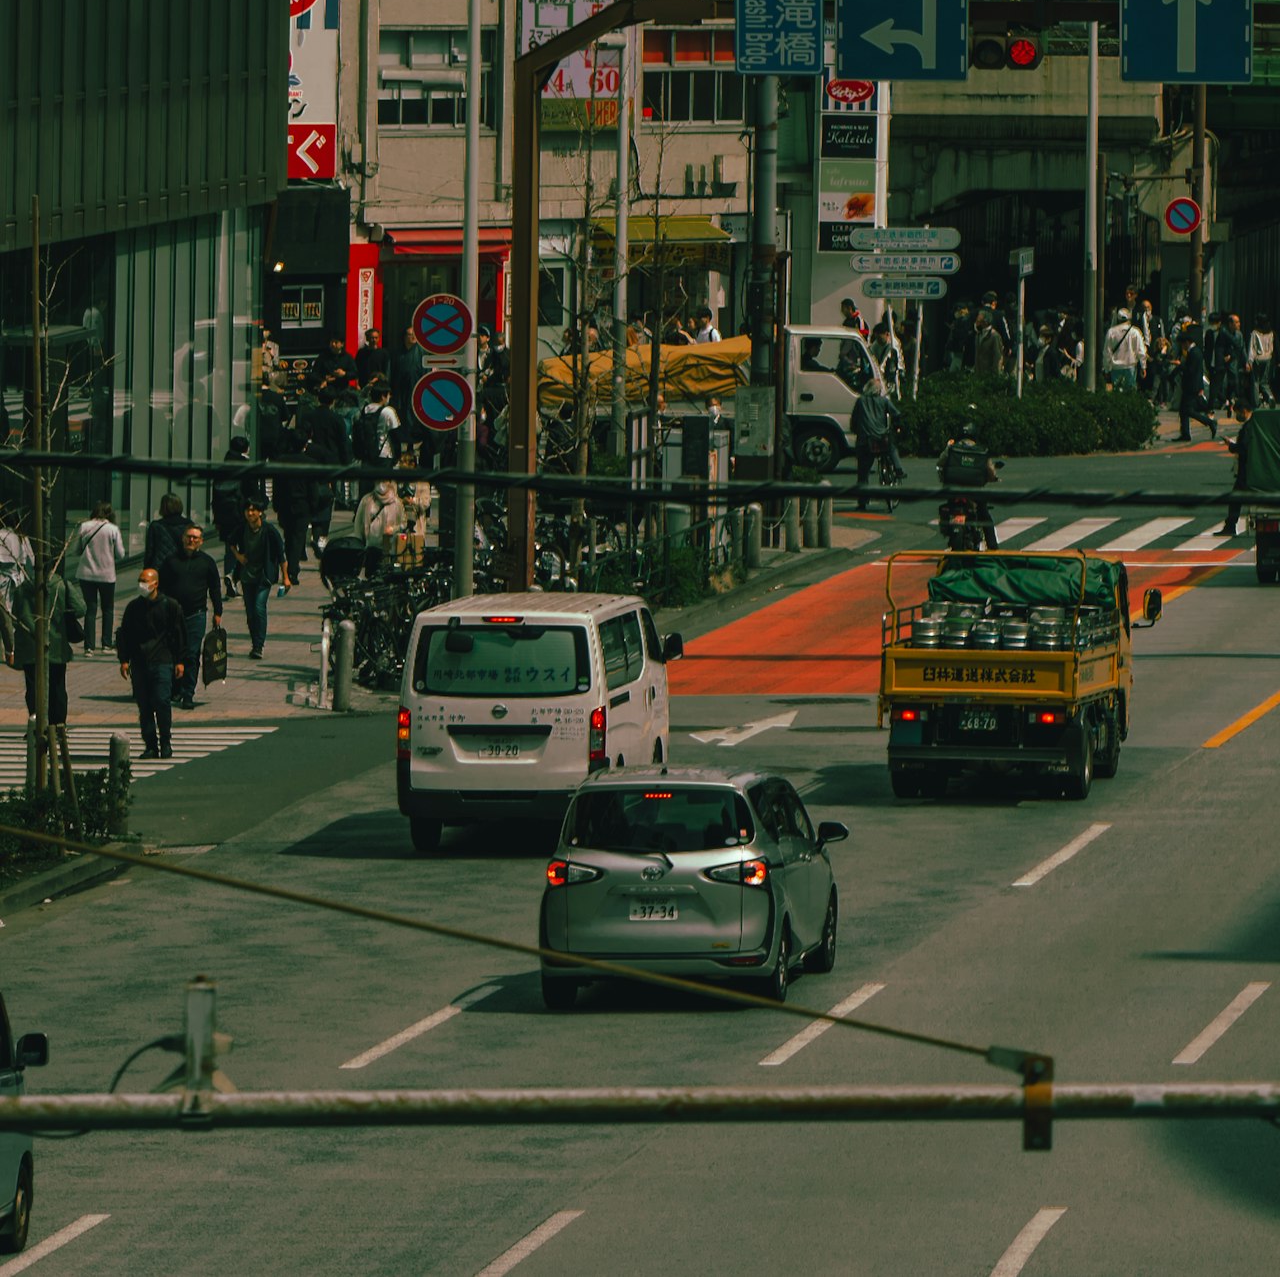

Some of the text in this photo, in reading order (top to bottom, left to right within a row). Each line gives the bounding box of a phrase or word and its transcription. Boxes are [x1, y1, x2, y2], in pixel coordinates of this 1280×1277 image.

[826, 128, 874, 145] Kaleido
[361, 289, 371, 331] 電子タバコ
[525, 666, 571, 684] ウスイ
[487, 744, 519, 757] 30-20
[639, 905, 676, 920] 37-34
